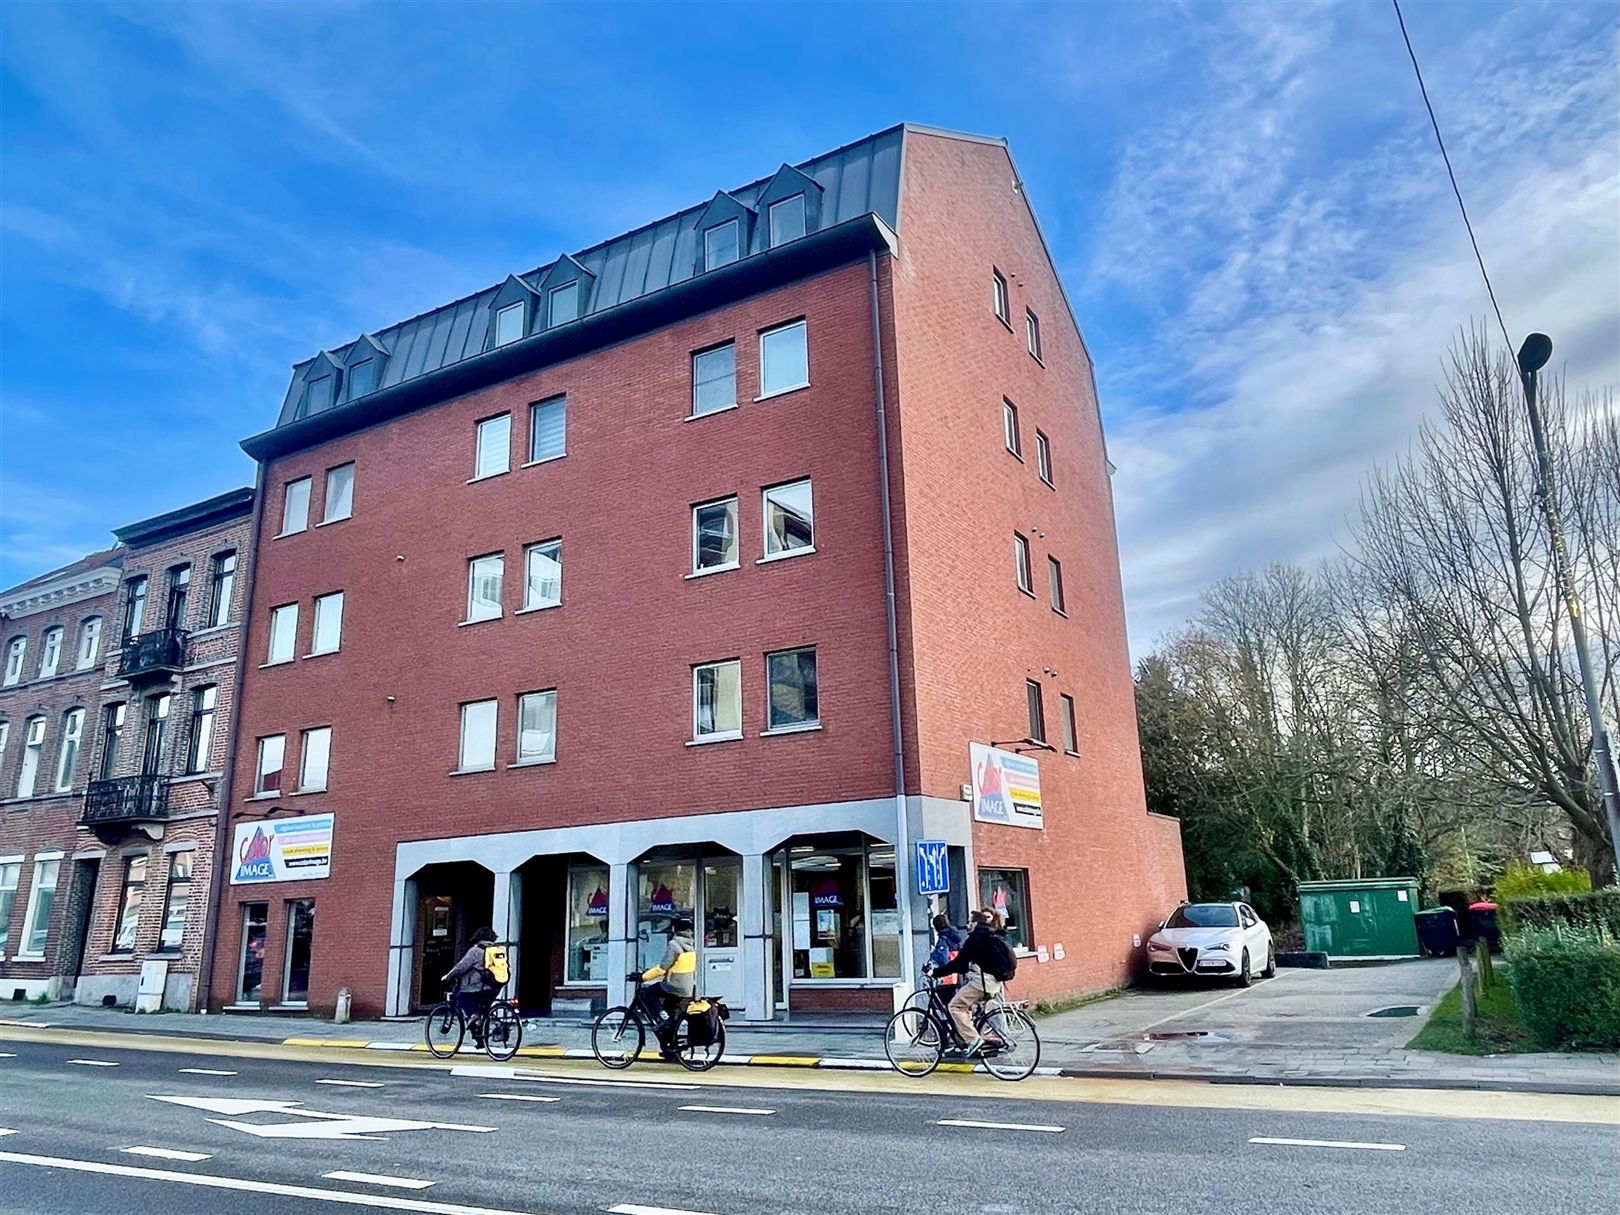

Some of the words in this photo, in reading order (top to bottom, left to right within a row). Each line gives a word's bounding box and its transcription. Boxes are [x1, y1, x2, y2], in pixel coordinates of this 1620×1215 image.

[981, 799, 1005, 815] IMAGE
[240, 863, 270, 877] IMAGE
[814, 895, 839, 904] IMAGE
[588, 906, 608, 914] IMAGE
[652, 903, 673, 911] IMAGE
